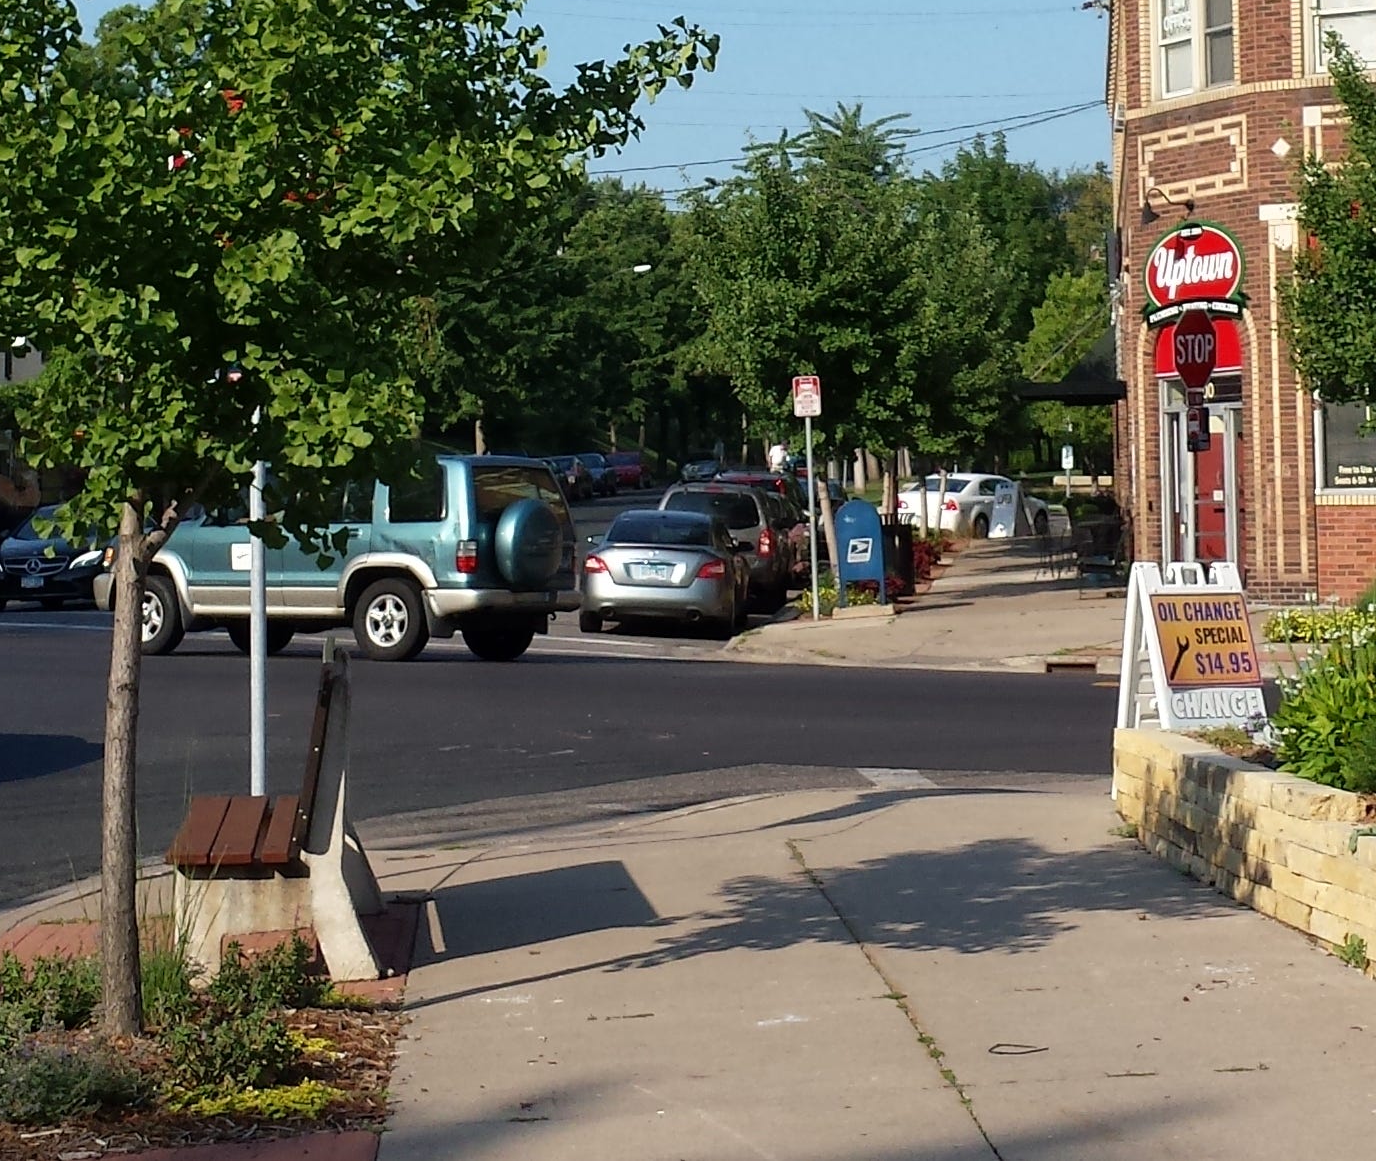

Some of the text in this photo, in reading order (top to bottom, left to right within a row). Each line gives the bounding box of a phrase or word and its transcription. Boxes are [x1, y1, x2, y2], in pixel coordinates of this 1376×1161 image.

[1153, 245, 1234, 299] Uptown
[1176, 334, 1214, 364] STOP
[1158, 601, 1243, 622] OIL CHANGE
[1194, 626, 1247, 644] SPECIAL
[1195, 652, 1252, 675] $14.95
[1171, 691, 1261, 720] CHANGE
